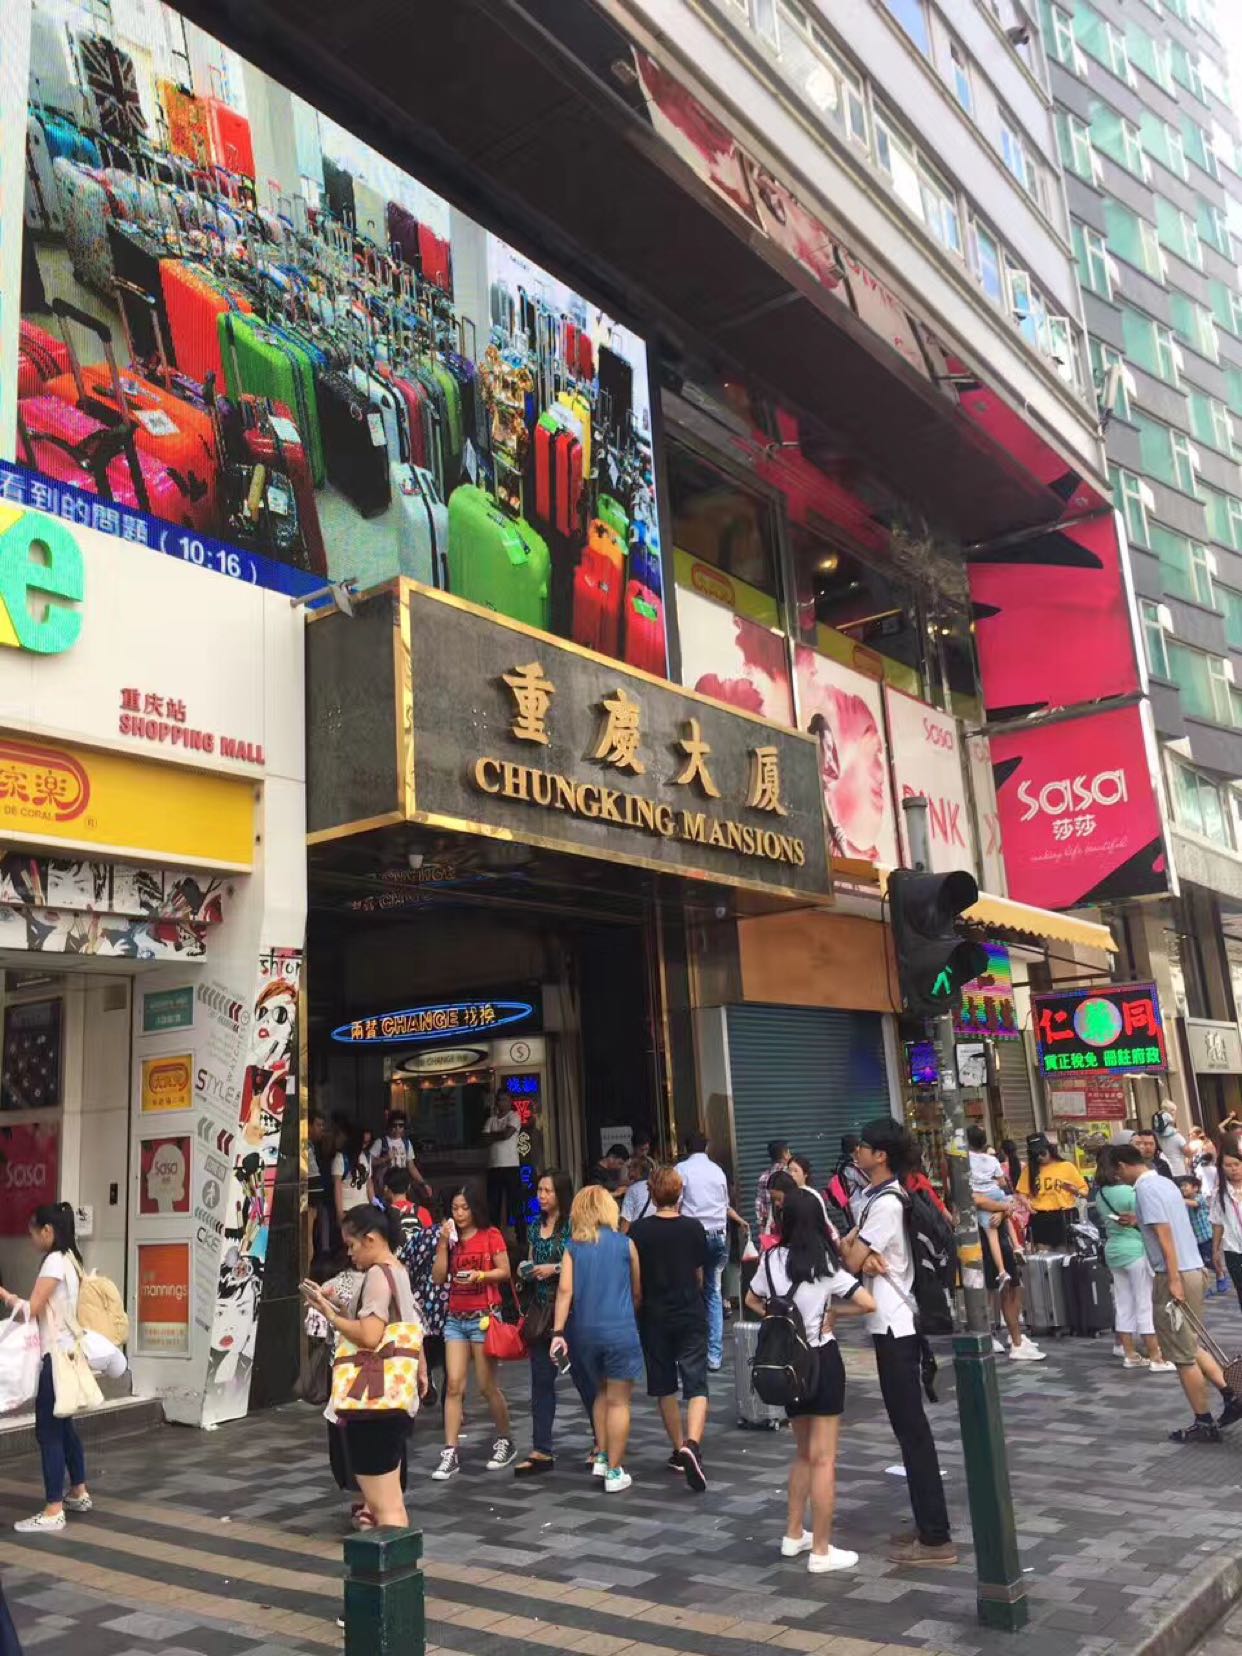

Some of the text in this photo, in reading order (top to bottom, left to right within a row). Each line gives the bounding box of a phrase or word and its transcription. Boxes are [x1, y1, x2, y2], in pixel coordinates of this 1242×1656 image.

[119, 687, 187, 723] 重庆站
[119, 713, 265, 765] SHOPPING MALL
[473, 756, 807, 867] CHUNGKING MANSIONS
[1052, 814, 1097, 841] 莎莎
[381, 1009, 459, 1036] CHANGE
[144, 1284, 187, 1300] mannings
